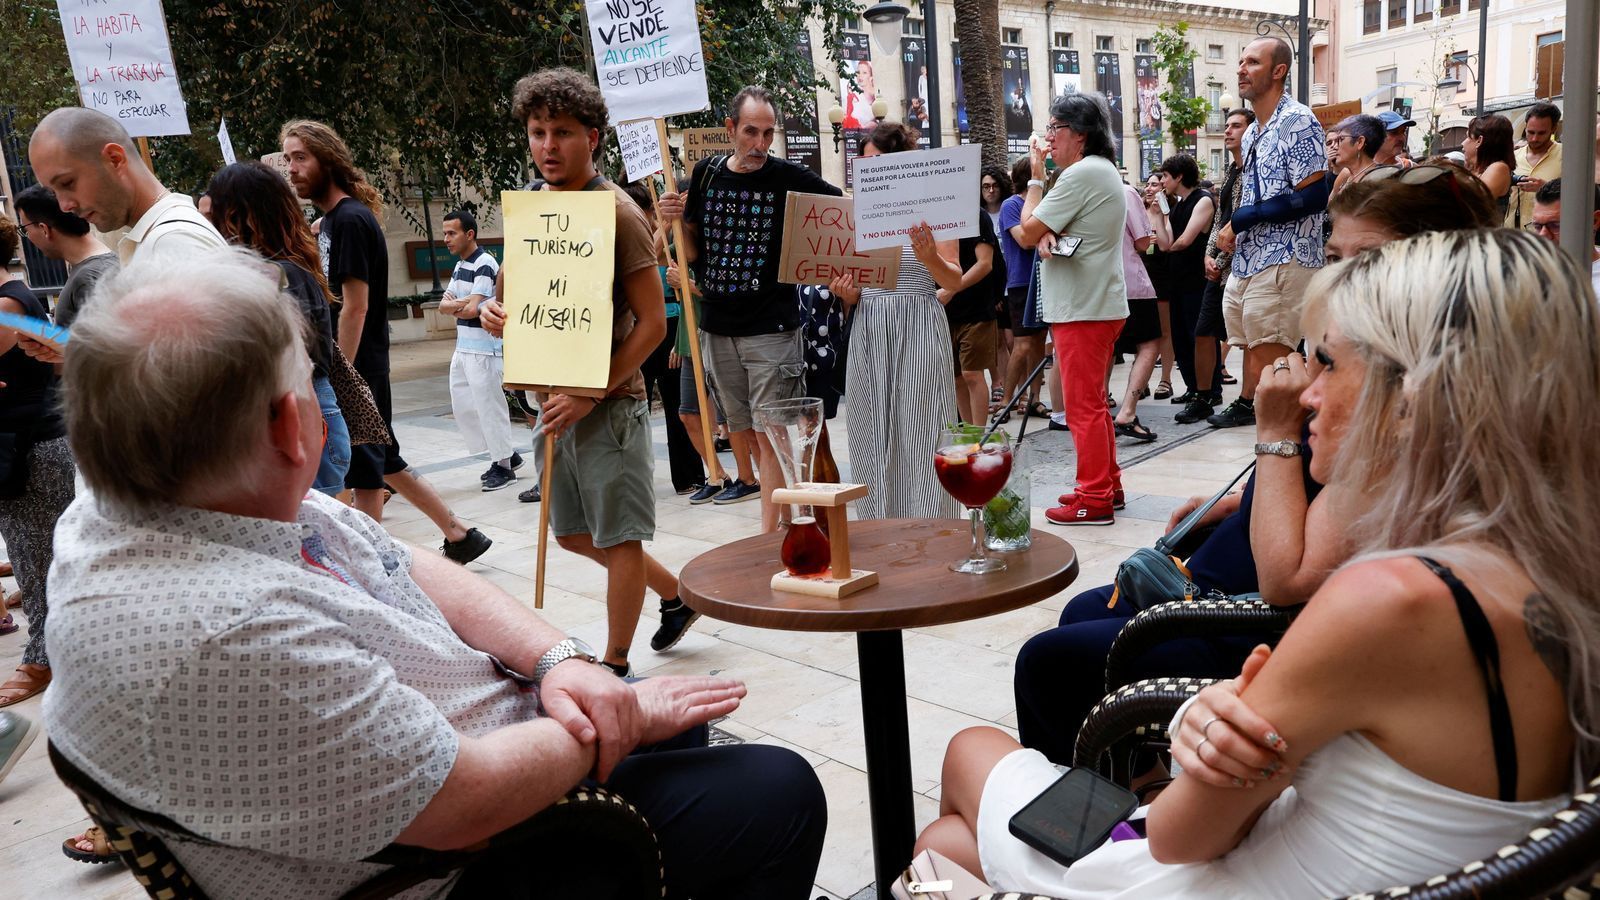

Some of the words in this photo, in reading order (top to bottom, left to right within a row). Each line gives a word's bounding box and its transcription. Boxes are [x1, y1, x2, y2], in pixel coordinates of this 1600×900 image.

[606, 0, 630, 20] NO
[632, 0, 662, 16] SE
[74, 16, 90, 35] LA
[96, 13, 142, 38] HABITA
[598, 10, 669, 45] VENDE
[106, 42, 112, 60] Y
[604, 35, 671, 66] ALICANTE
[86, 66, 102, 83] LA
[108, 62, 166, 82] TRABAJA
[606, 69, 629, 86] SE
[635, 52, 702, 84] DEFIENDE
[92, 92, 108, 108] NO
[114, 90, 142, 105] PARA
[118, 104, 170, 118] ESPECULAR
[620, 130, 640, 144] QUIEN
[642, 125, 648, 133] LO
[642, 134, 652, 144] NO
[689, 133, 699, 145] EL
[624, 150, 640, 164] PARA
[643, 140, 659, 154] QUIEN
[688, 150, 700, 161] EL
[628, 165, 636, 174] LO
[638, 153, 660, 170] VISITA
[870, 164, 900, 174] GUSTARÍA
[540, 214, 570, 233] TU
[802, 204, 854, 232] AQU
[897, 226, 924, 236] CIUDD
[926, 222, 958, 232] NVADIDA
[1076, 509, 1087, 517] S
